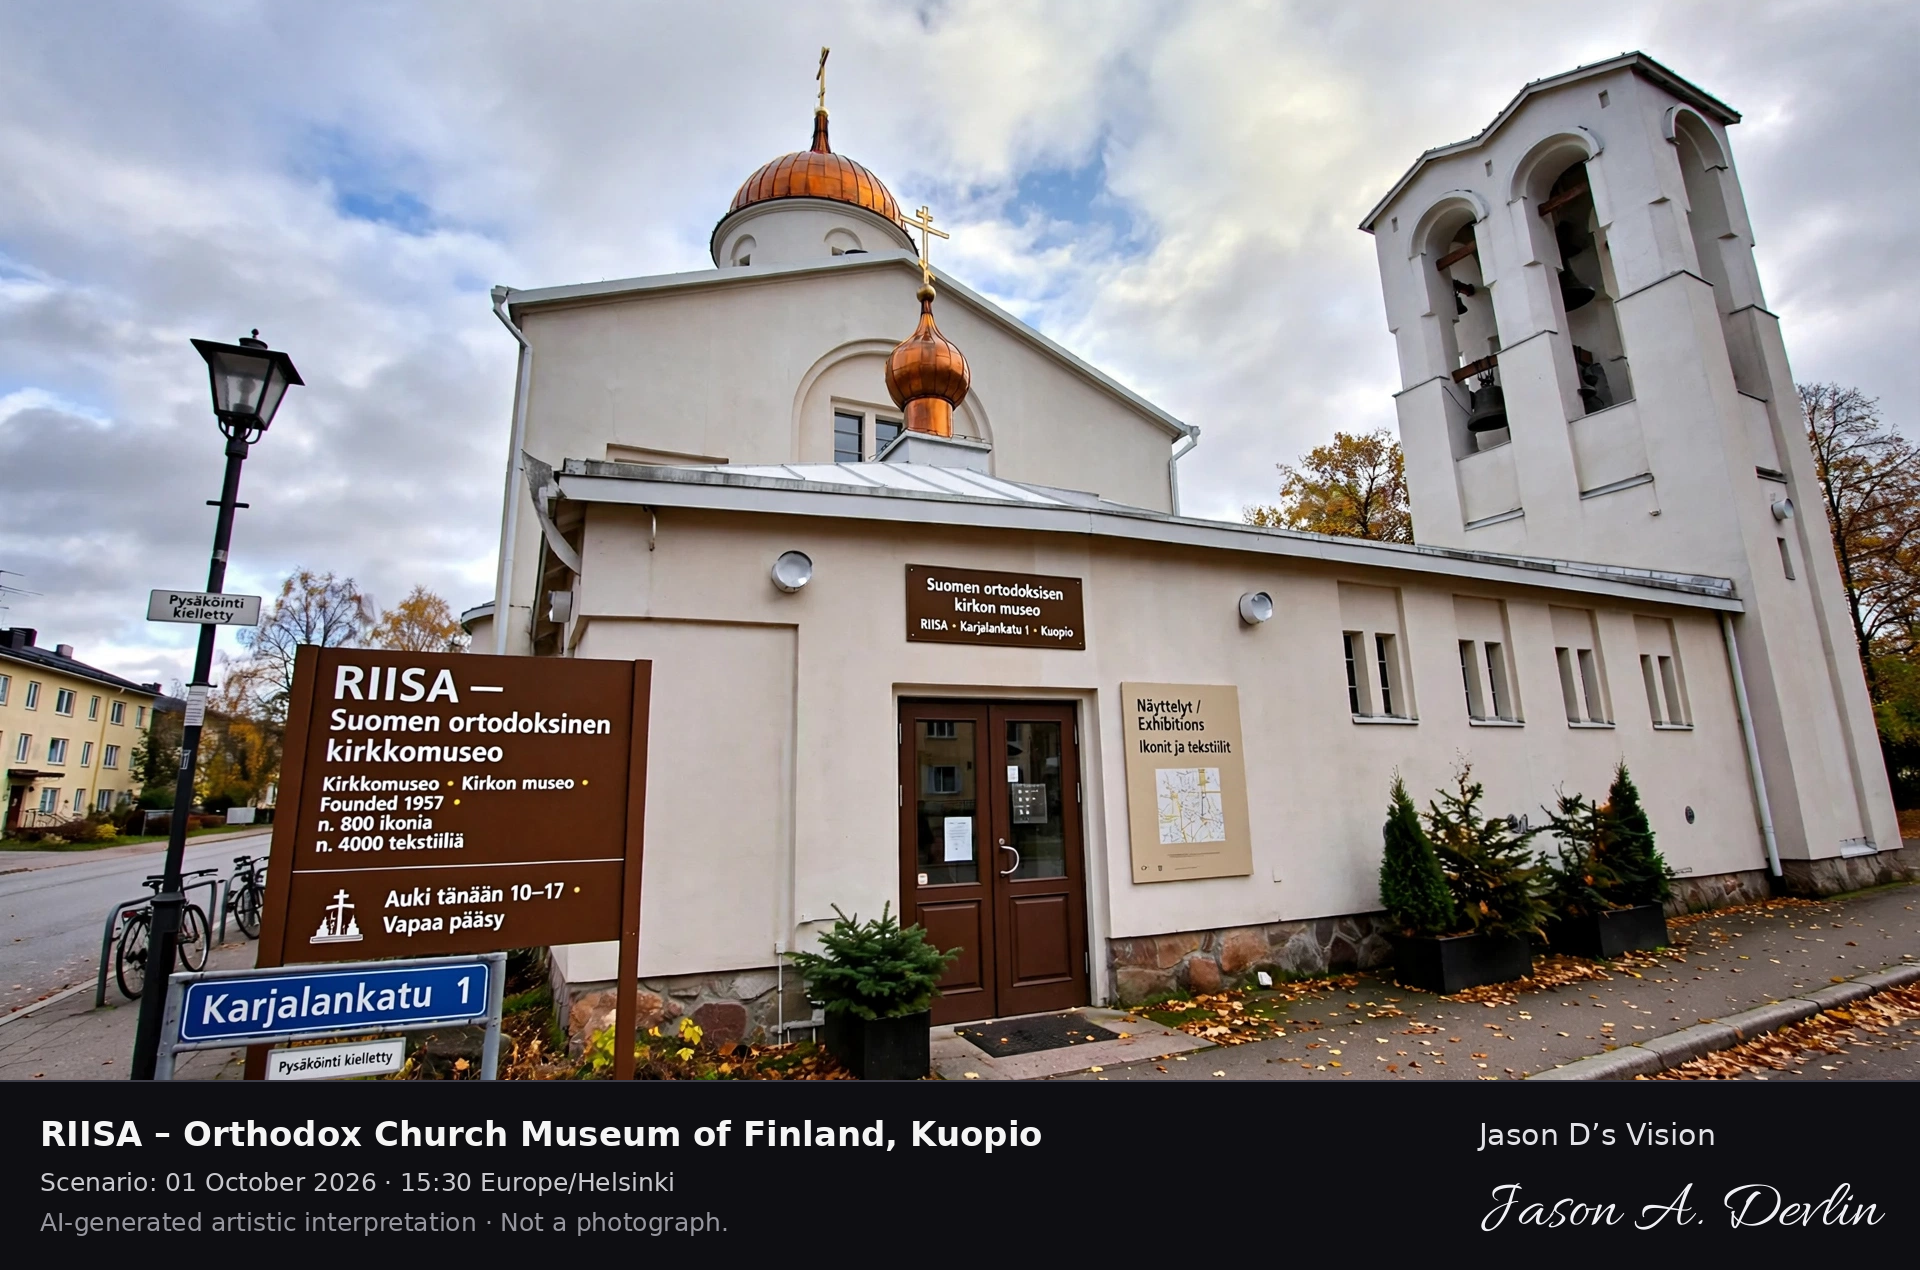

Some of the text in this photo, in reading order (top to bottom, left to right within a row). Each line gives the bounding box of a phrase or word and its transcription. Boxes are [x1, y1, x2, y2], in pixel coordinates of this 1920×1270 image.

[926, 577, 1064, 601] Suomen ortodoksisen
[169, 594, 245, 609] Pysäköinti
[954, 597, 1041, 617] kirkon museo
[173, 606, 234, 623] kielletty
[920, 618, 1074, 640] RIISA Karjalankatu 1 Kuopio
[334, 665, 459, 703] RIISA
[1137, 699, 1193, 717] Näyttelyt
[330, 708, 611, 735] Suomen ortodoksinen
[1138, 716, 1205, 731] Exhibitions
[326, 738, 504, 763] kirkkomuseo
[1139, 739, 1232, 756] Ikonit ja tekstiilit
[322, 775, 575, 792] Kirkkomuseo Kirkon museo
[320, 795, 444, 813] Founded 1957
[317, 814, 433, 832] n. 800 ikonia
[315, 832, 464, 853] n. 4000 tekstiiliä
[384, 887, 431, 909] Auki
[437, 885, 504, 905] tänään
[382, 910, 506, 937] Vapaa pääsy
[202, 976, 471, 1029] Karjalankatu 1
[278, 1051, 393, 1073] Pysäköinti kielletty
